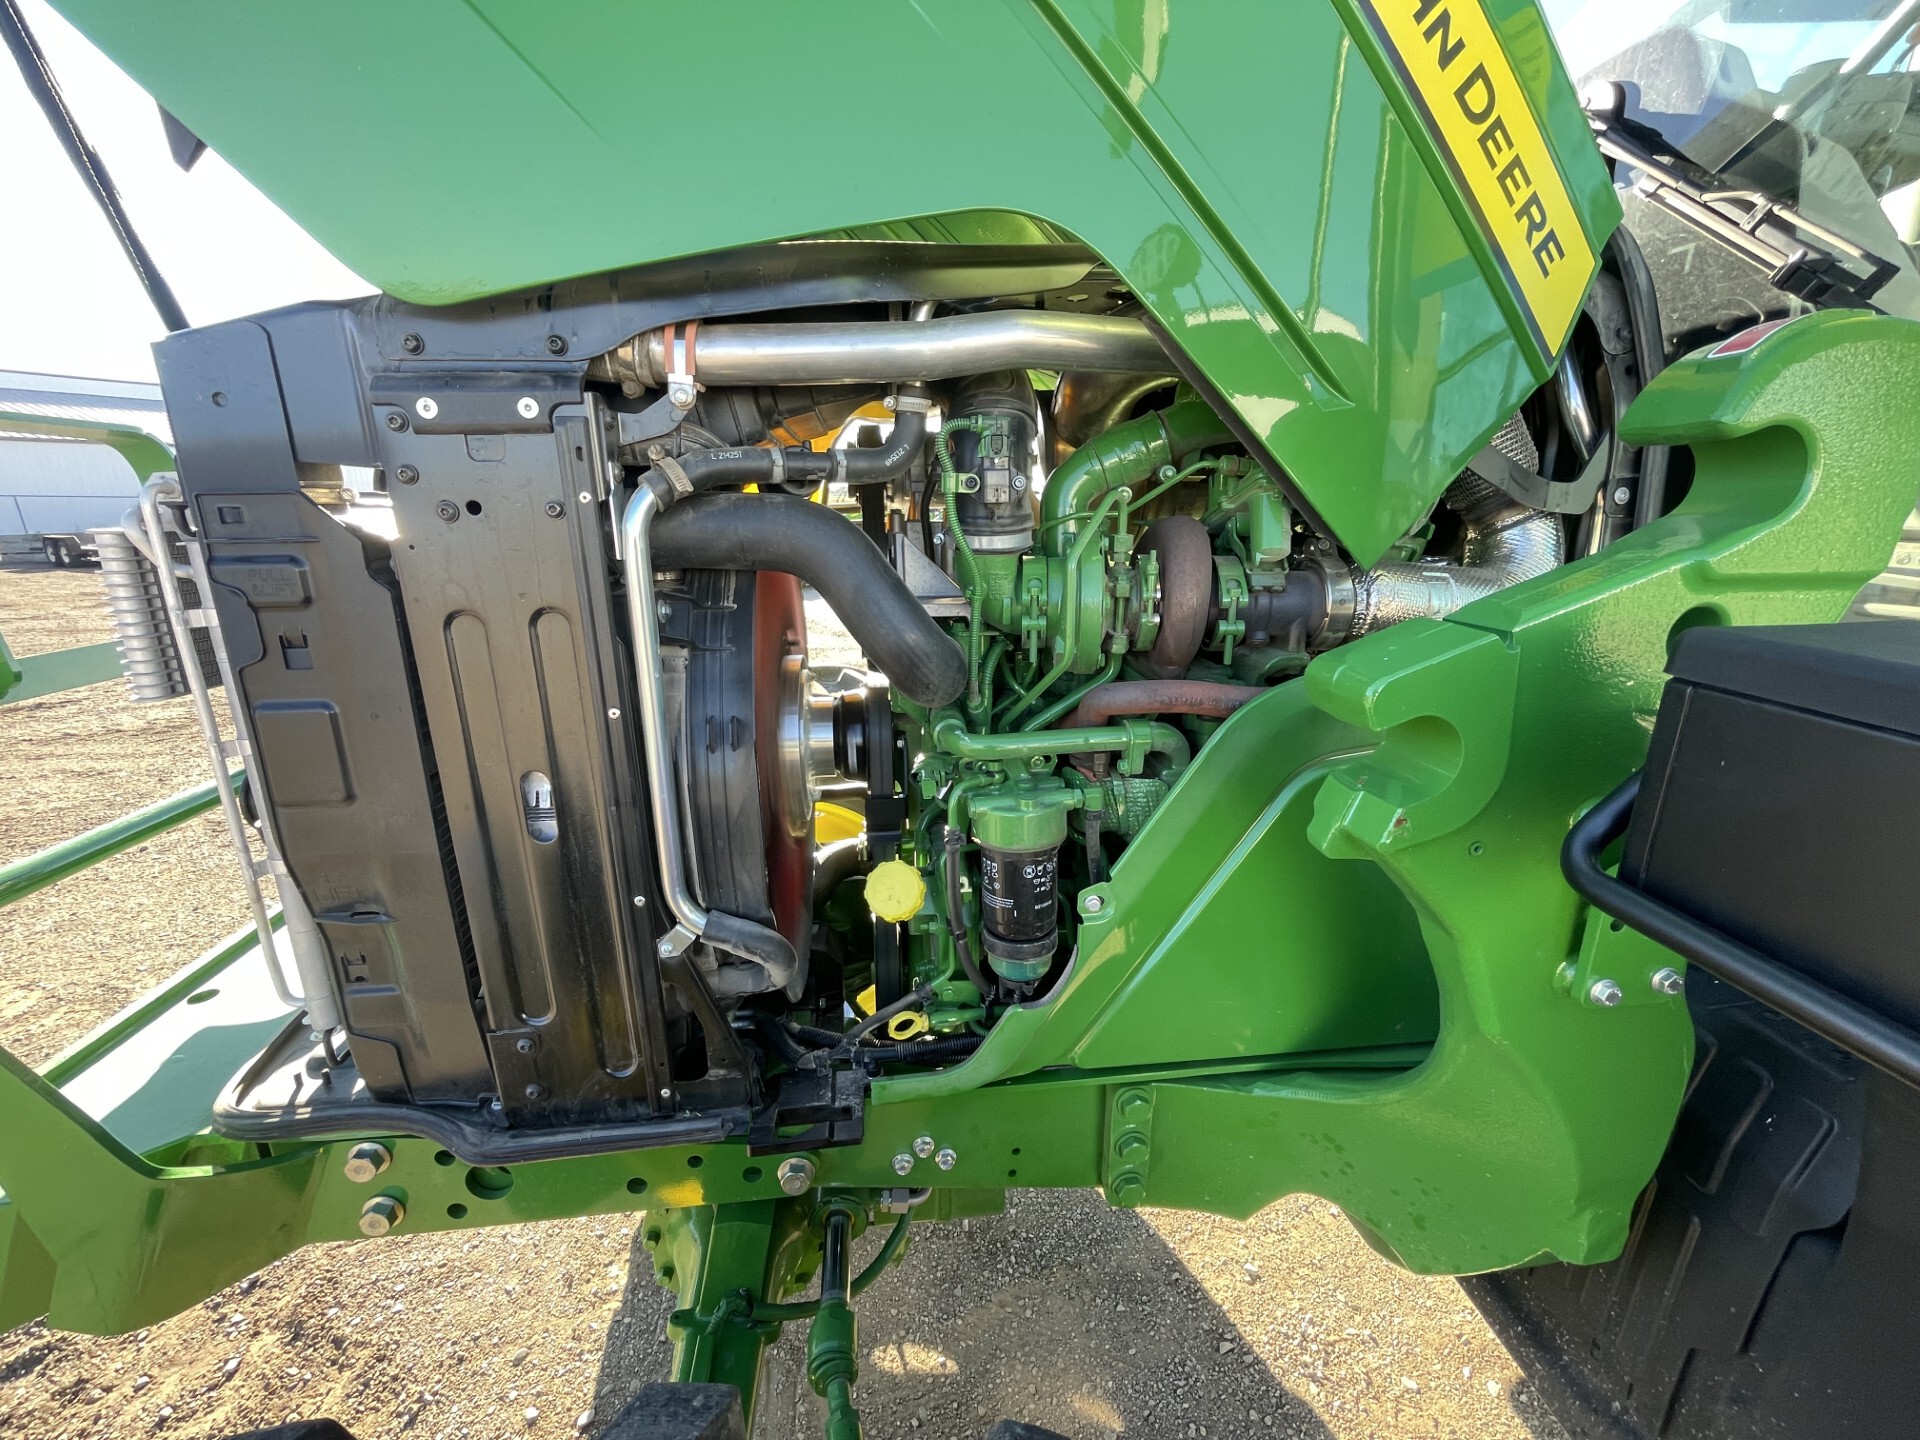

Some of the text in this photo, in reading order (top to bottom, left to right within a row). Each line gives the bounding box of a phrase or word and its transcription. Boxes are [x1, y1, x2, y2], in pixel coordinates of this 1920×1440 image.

[1453, 61, 1566, 280] DEERE
[710, 452, 717, 460] L
[247, 568, 293, 582] PULL
